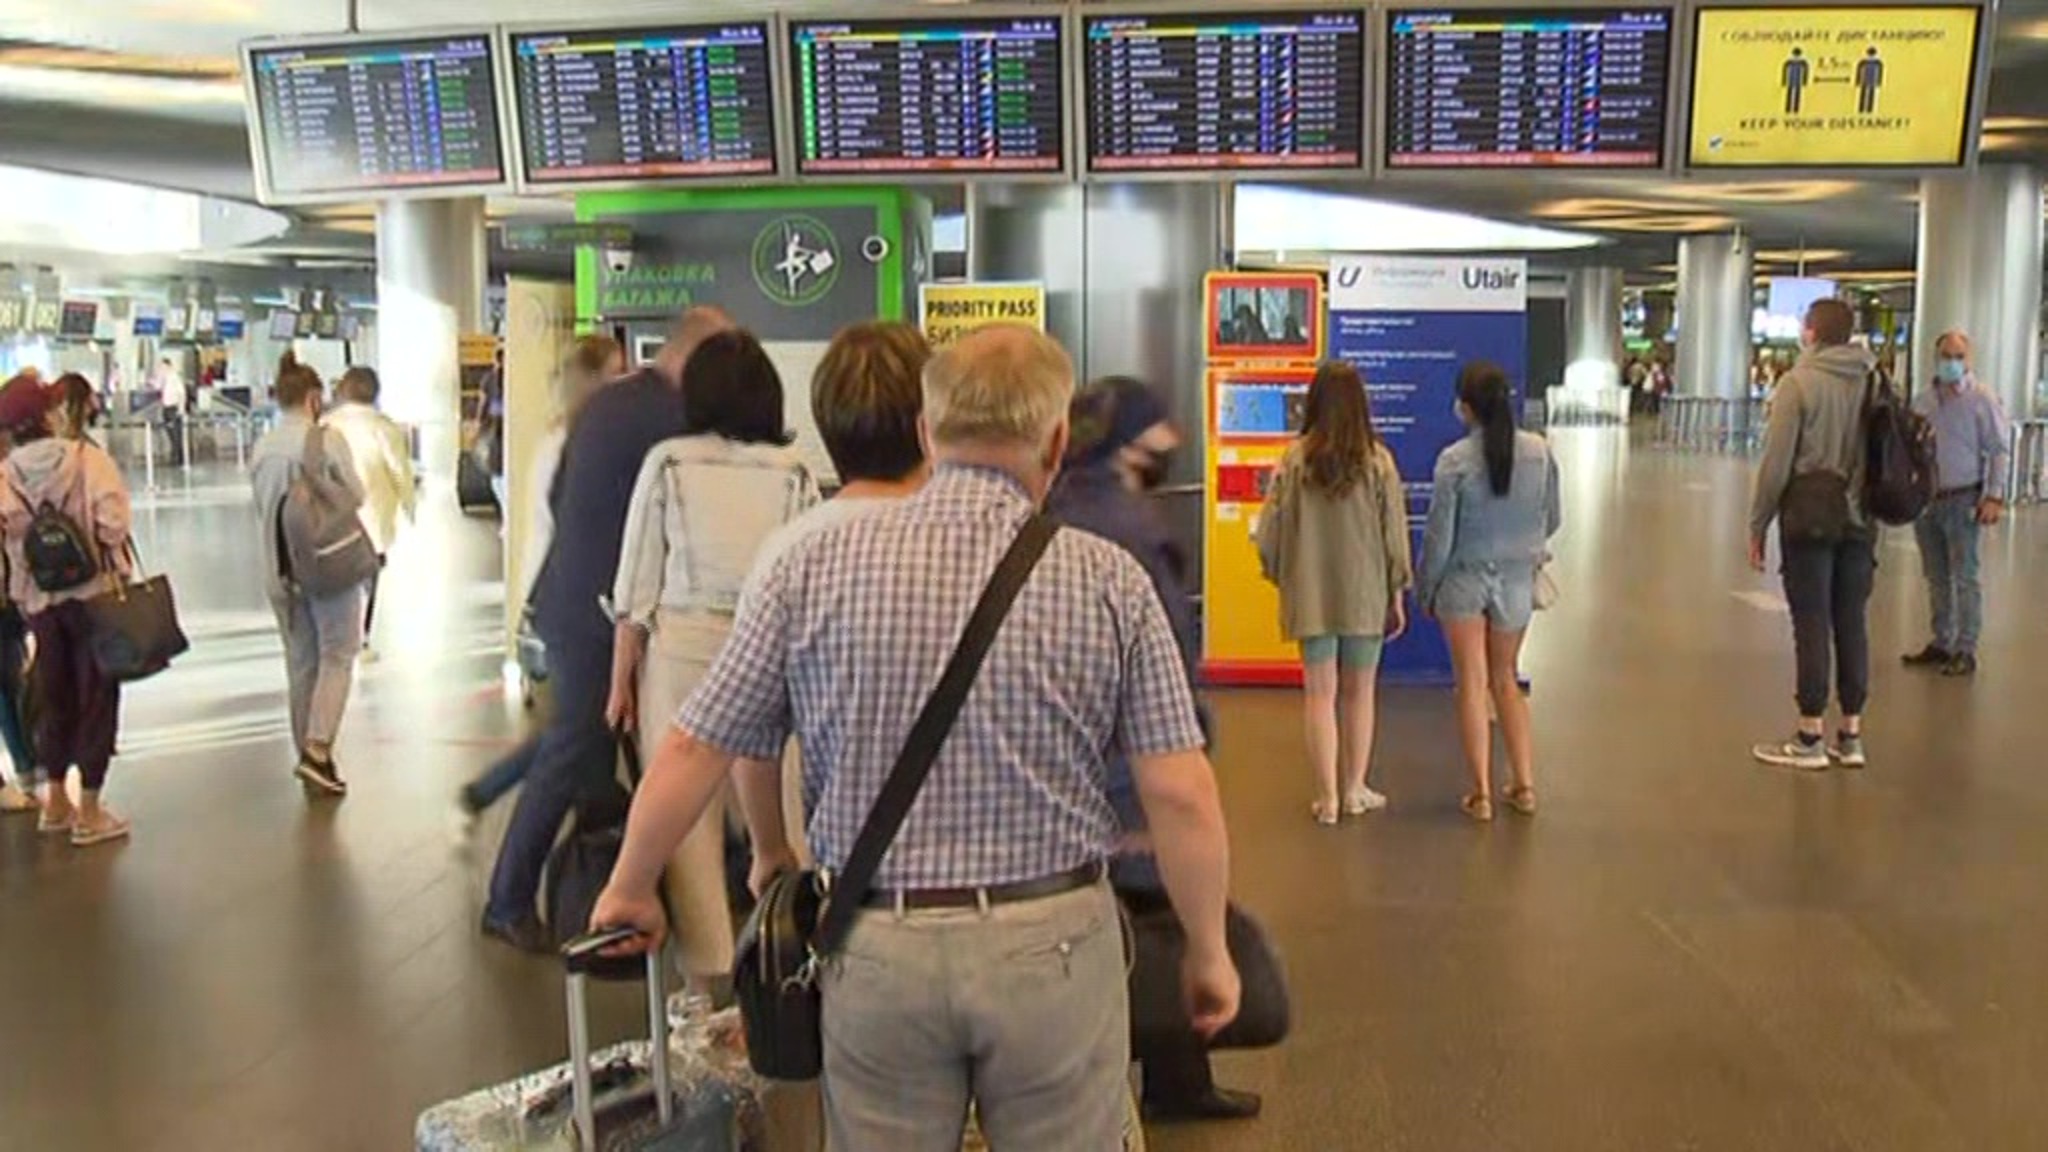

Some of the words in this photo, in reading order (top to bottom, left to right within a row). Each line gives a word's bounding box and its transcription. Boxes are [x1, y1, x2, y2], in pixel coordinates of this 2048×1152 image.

[1739, 117, 1778, 129] KEEP
[1783, 117, 1825, 130] YOUR
[1828, 116, 1911, 129] DISTANCE!
[1462, 266, 1520, 289] Utair
[927, 300, 995, 317] PRIORITY
[998, 299, 1036, 317] PASS
